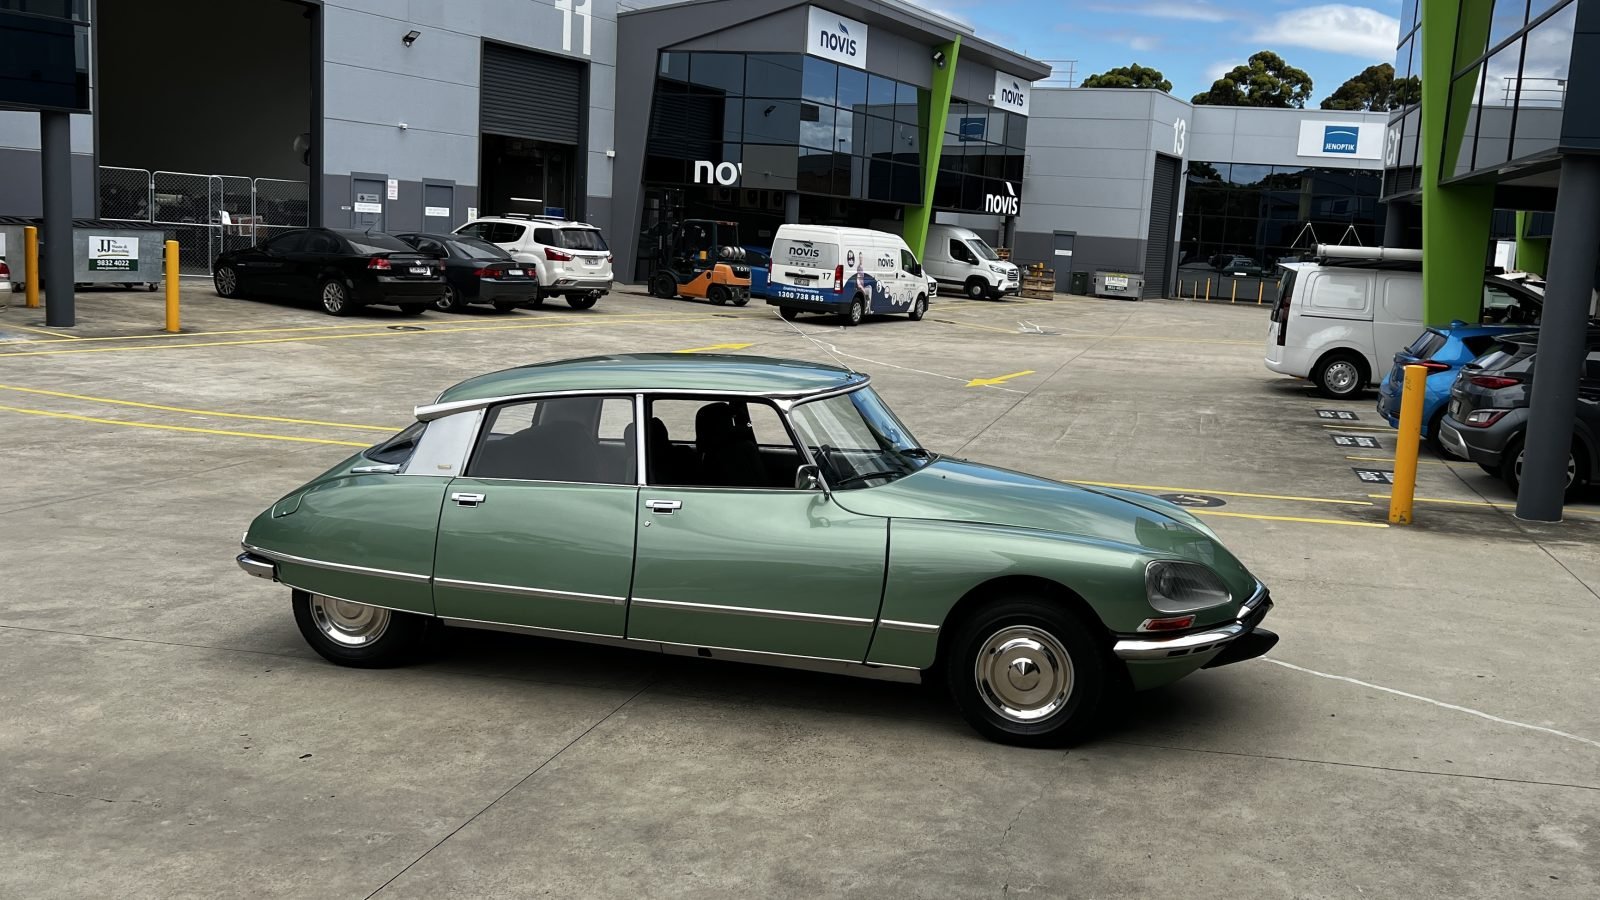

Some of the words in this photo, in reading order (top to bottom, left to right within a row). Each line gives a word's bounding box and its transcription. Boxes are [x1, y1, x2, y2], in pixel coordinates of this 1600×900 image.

[554, 0, 592, 56] 11
[820, 30, 857, 57] novis
[1001, 88, 1025, 107] novis
[1173, 117, 1186, 156] 13
[1325, 143, 1355, 151] JENOPTIK
[985, 193, 1019, 215] novis
[789, 246, 820, 258] novis
[877, 258, 895, 268] novis
[822, 272, 832, 281] 17
[777, 290, 795, 299] 1300
[795, 292, 809, 300] 738
[810, 294, 824, 302] 885
